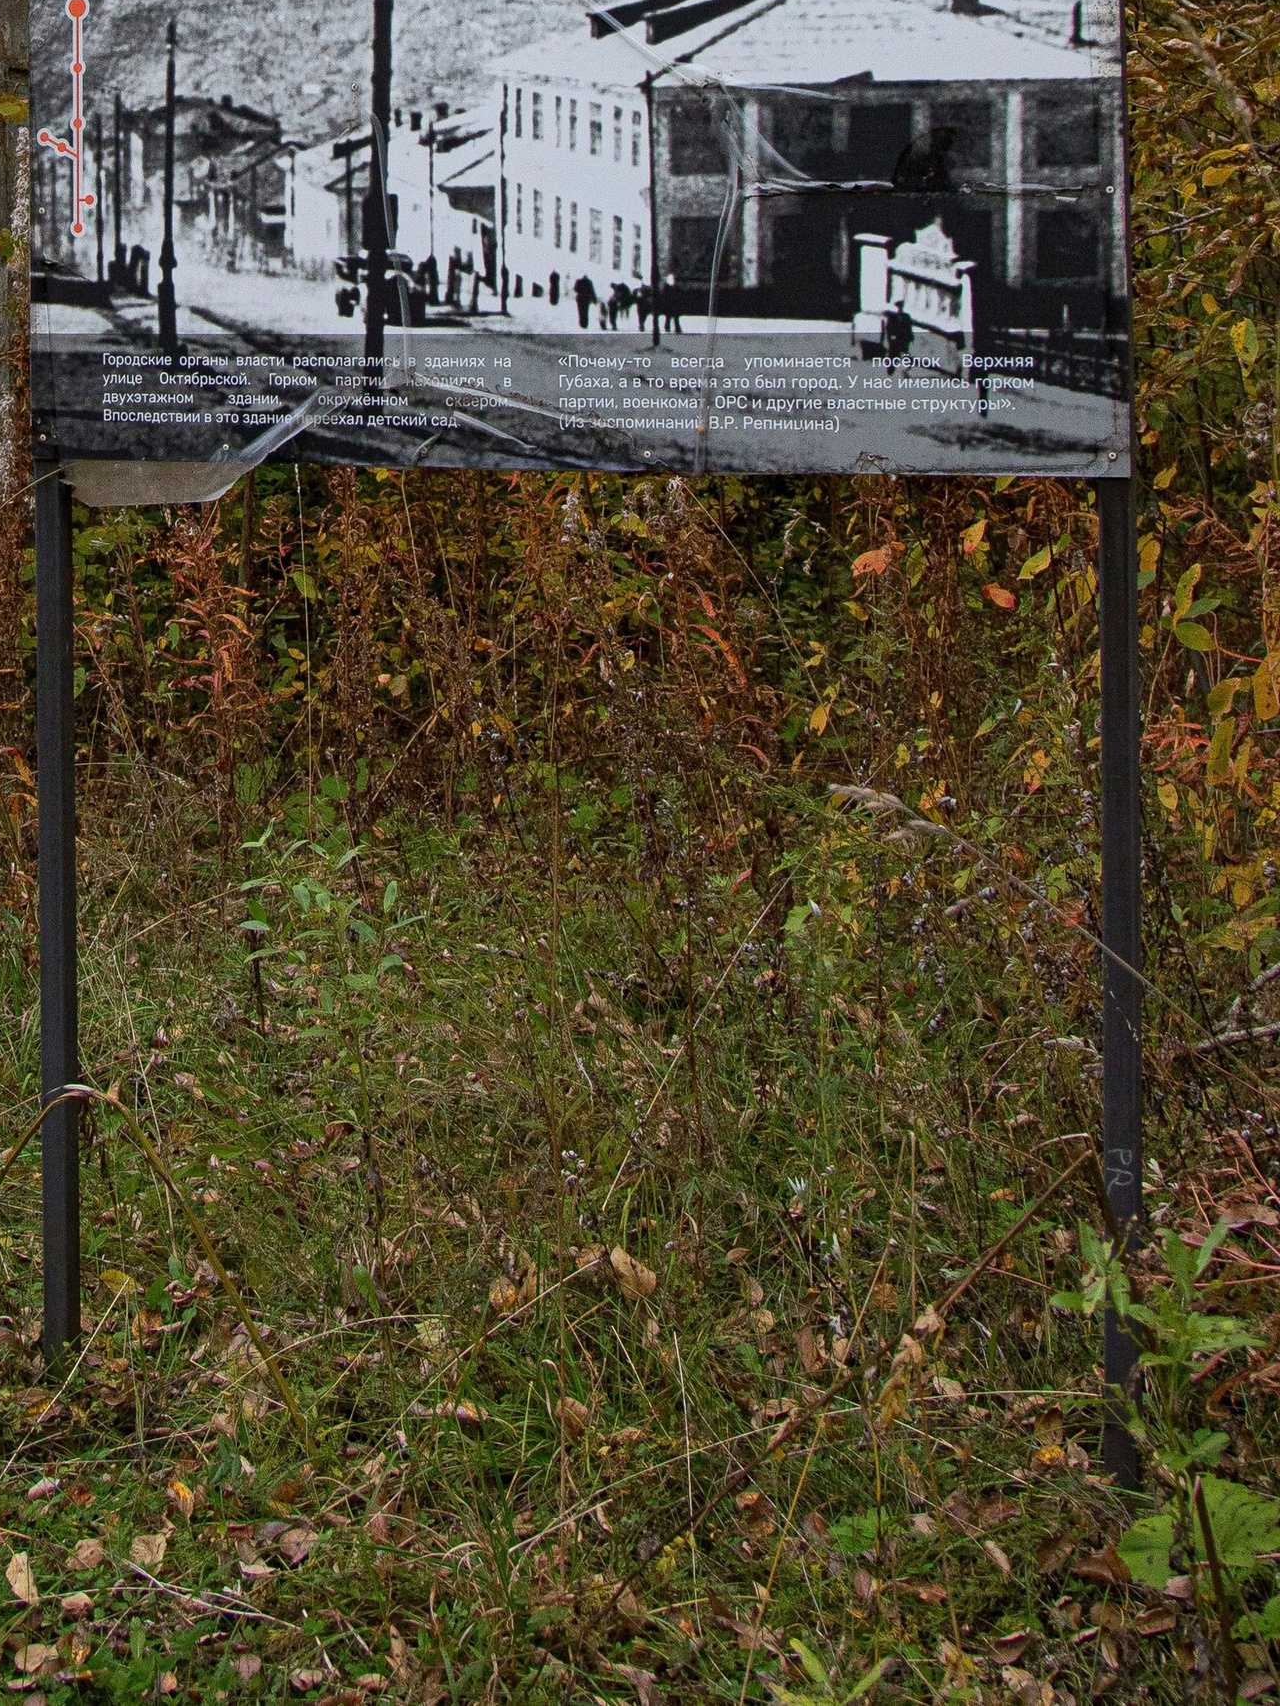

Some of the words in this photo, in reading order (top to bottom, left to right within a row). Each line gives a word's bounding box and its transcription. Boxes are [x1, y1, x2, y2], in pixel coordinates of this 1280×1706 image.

[102, 353, 172, 368] Городские
[179, 355, 229, 368] органы
[236, 356, 285, 367] власти
[293, 356, 400, 370] располагались
[409, 357, 417, 367] в
[424, 356, 486, 369] зданиях
[494, 356, 512, 368] на
[558, 355, 651, 370] «Почему-то
[671, 357, 724, 370] всегда
[744, 356, 851, 371] упоминается
[872, 354, 941, 368] посёлок
[962, 354, 1034, 371] Верхняя
[102, 373, 143, 387] улице
[159, 372, 251, 388] Октябрьской.
[269, 373, 317, 389] Горком
[335, 375, 387, 389] партии
[503, 377, 512, 387] в
[559, 374, 614, 391] Губаха,
[619, 377, 627, 388] а
[633, 377, 641, 388] в
[647, 377, 664, 388] то
[669, 377, 717, 391] время
[722, 377, 750, 388] это
[755, 374, 786, 388] был
[791, 377, 842, 392] город.
[848, 375, 858, 388] У
[863, 377, 893, 388] нас
[898, 377, 970, 389] имелись
[975, 377, 1034, 392] горком
[102, 392, 194, 406] двухэтажном
[228, 395, 282, 407] здании,
[318, 393, 408, 409] окружённом
[559, 398, 618, 411] партии,
[715, 395, 748, 409] ОРС
[752, 398, 762, 409] и
[766, 398, 822, 412] другие
[827, 398, 907, 410] властные
[911, 398, 1016, 413] структуры».
[103, 409, 201, 424] Впоследствии
[204, 412, 212, 423] в
[216, 412, 239, 424] это
[242, 413, 292, 425] здание
[367, 413, 427, 427] детский
[431, 416, 461, 428] сад.
[559, 414, 585, 431] (Из
[709, 415, 738, 429] В.Р.
[743, 415, 840, 432] Репницина)
